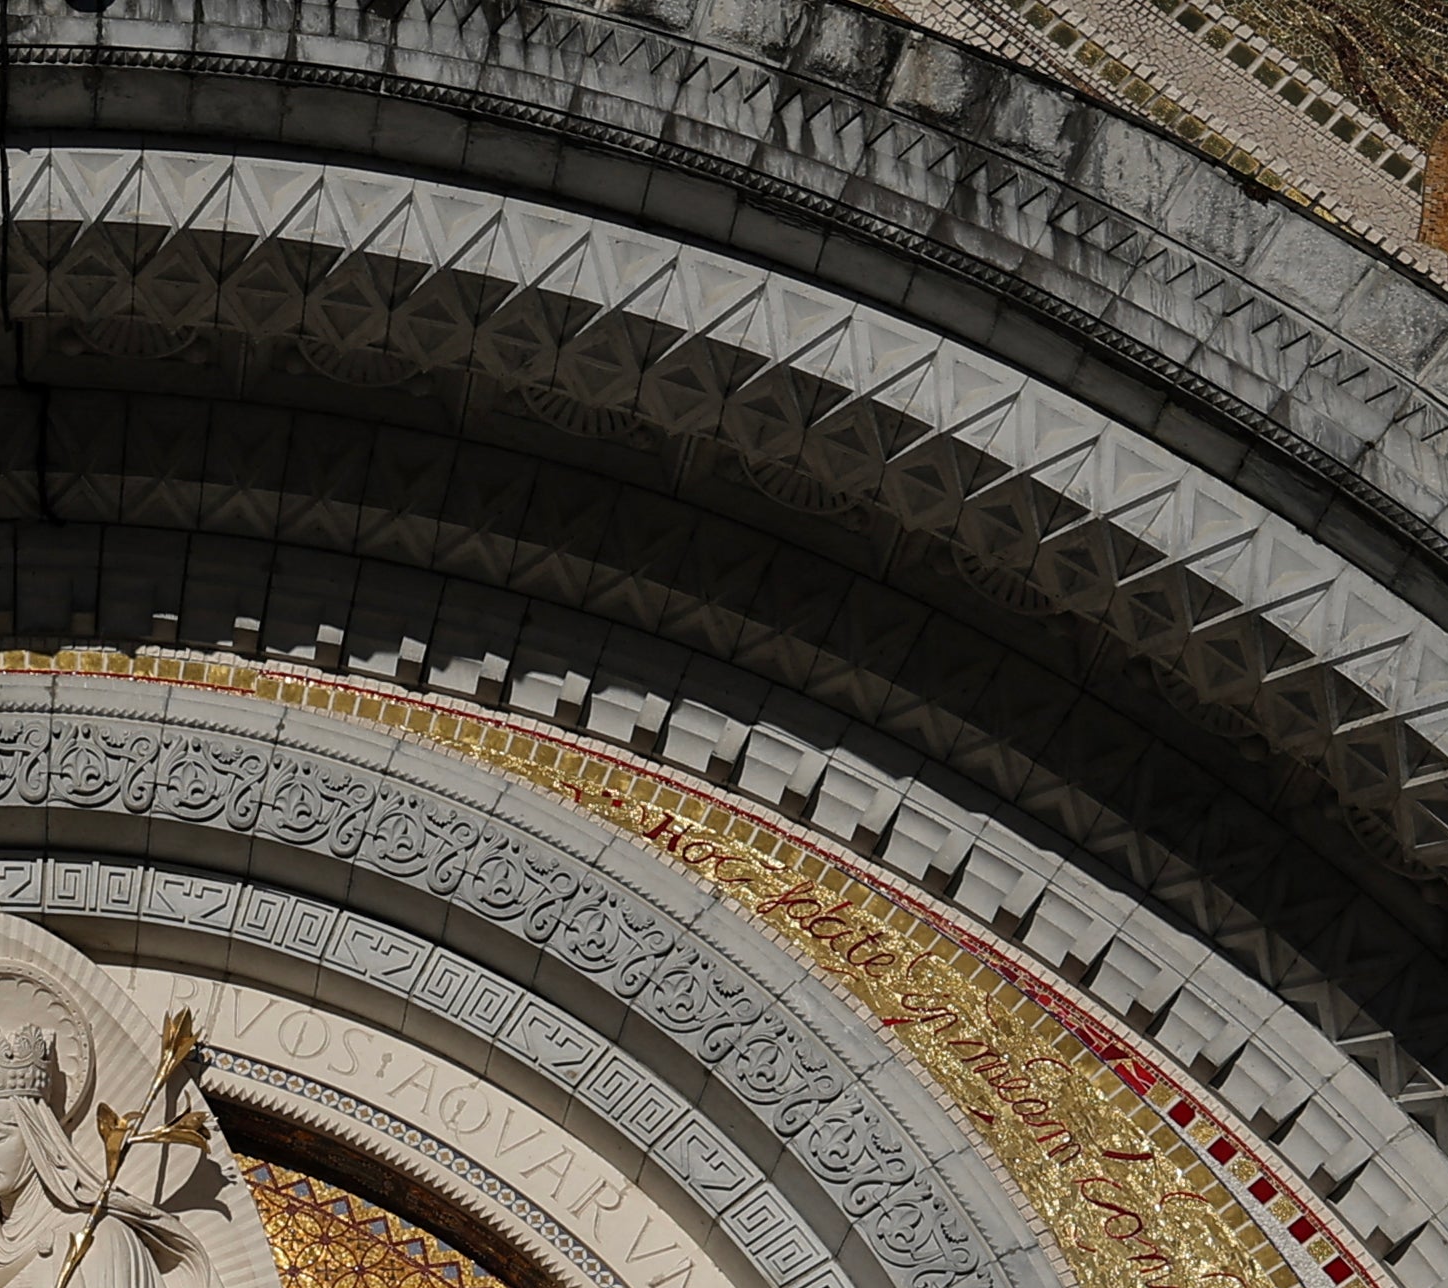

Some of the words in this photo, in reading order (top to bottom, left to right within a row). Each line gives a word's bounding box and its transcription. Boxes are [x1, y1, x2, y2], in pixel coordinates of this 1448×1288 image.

[639, 822, 757, 884] Hoc
[756, 880, 897, 979] facite
[946, 1040, 1084, 1164] meam
